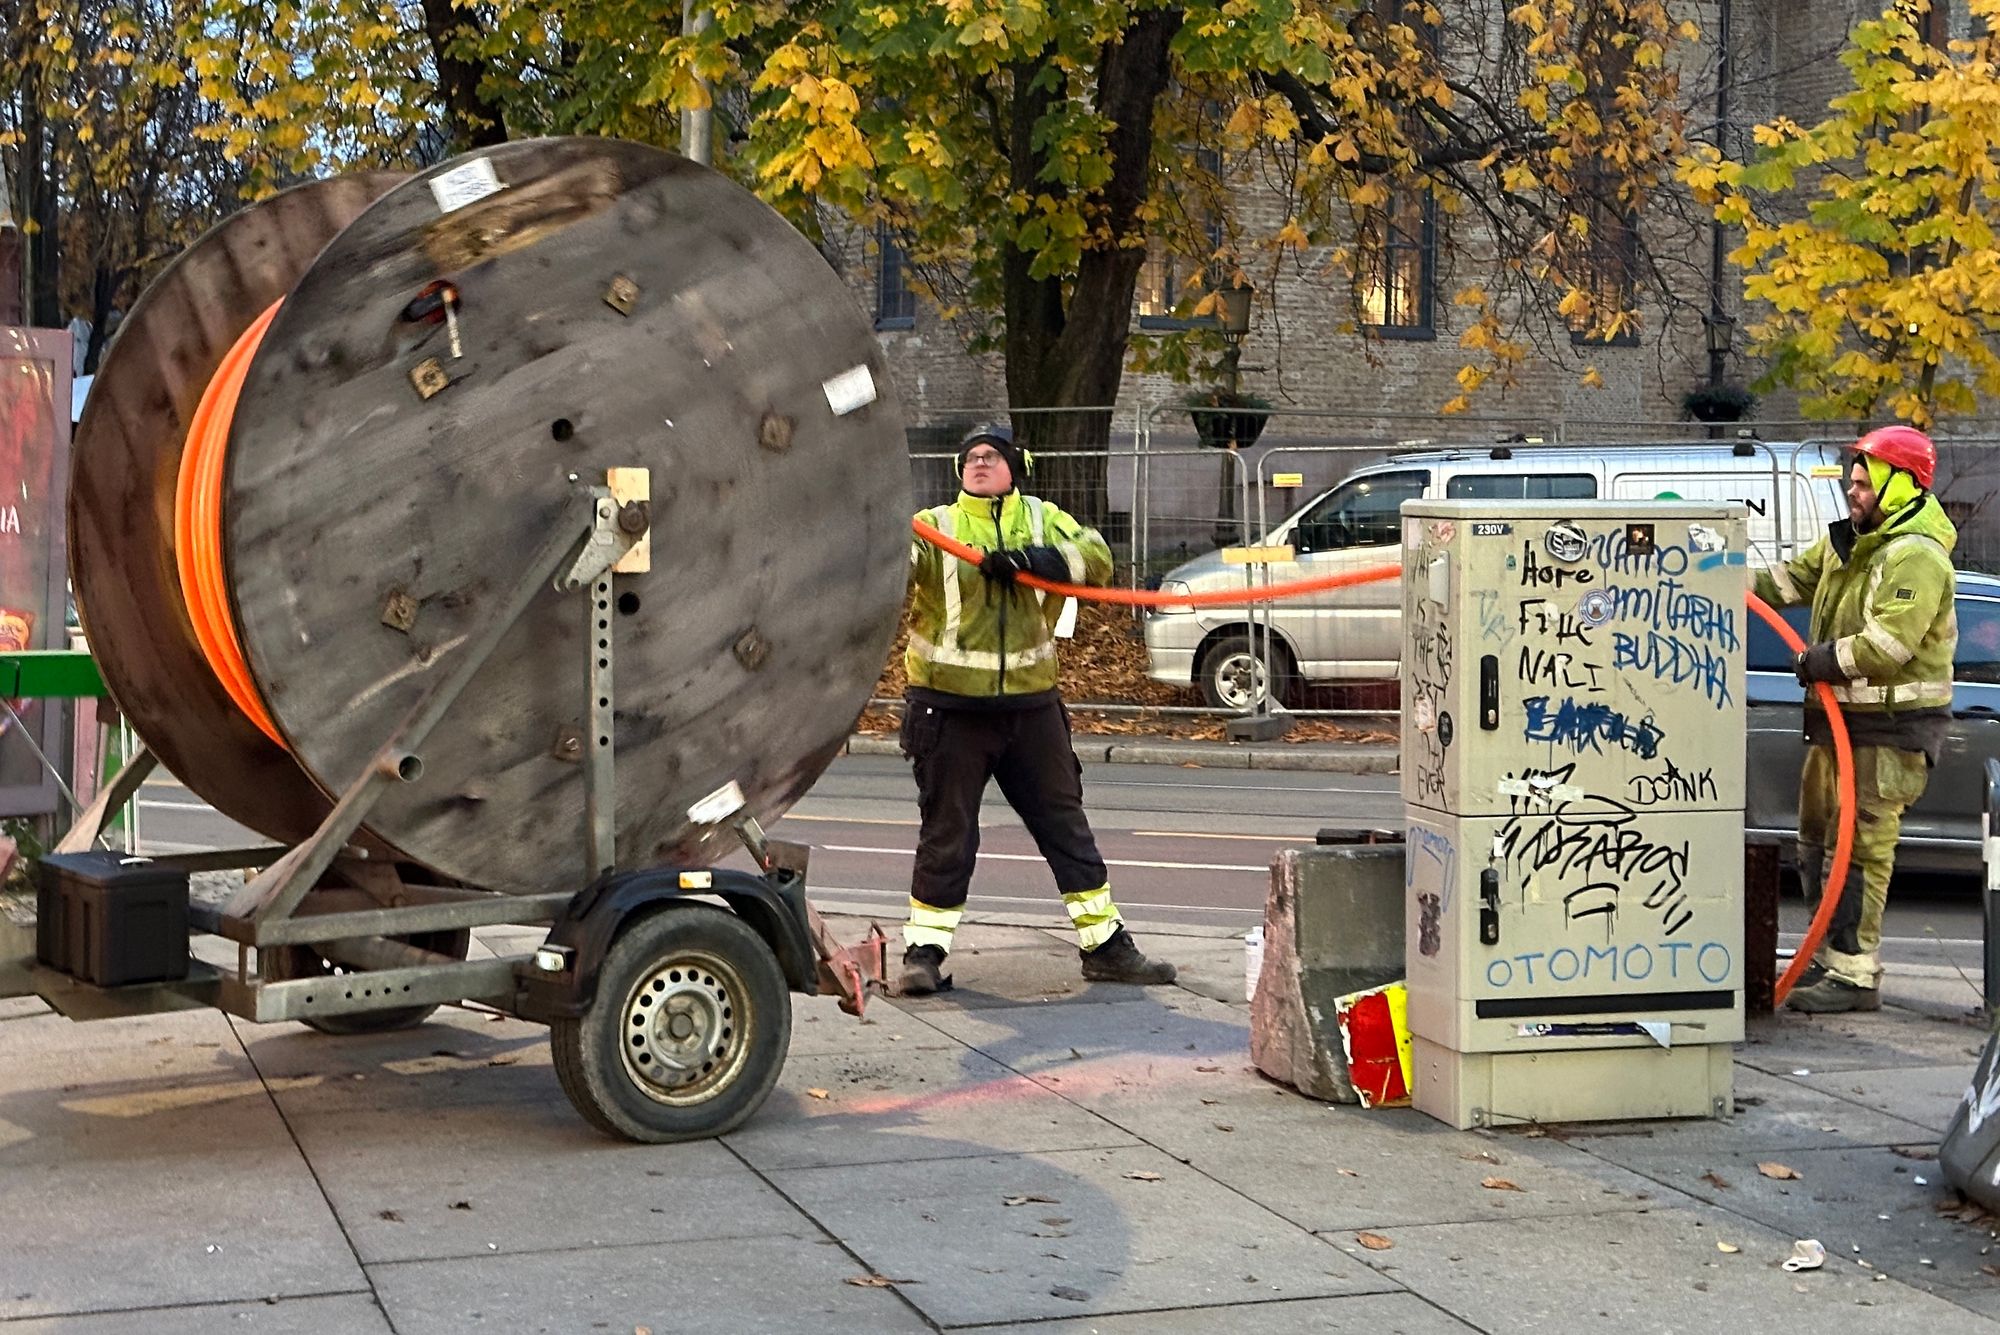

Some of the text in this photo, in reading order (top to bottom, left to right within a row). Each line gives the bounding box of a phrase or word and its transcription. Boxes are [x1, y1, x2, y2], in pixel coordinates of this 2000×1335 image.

[1477, 525, 1504, 535] 230V
[1521, 540, 1594, 588] Hore
[1612, 630, 1734, 710] BUDDHA
[1487, 942, 1731, 988] OTOMOTO
